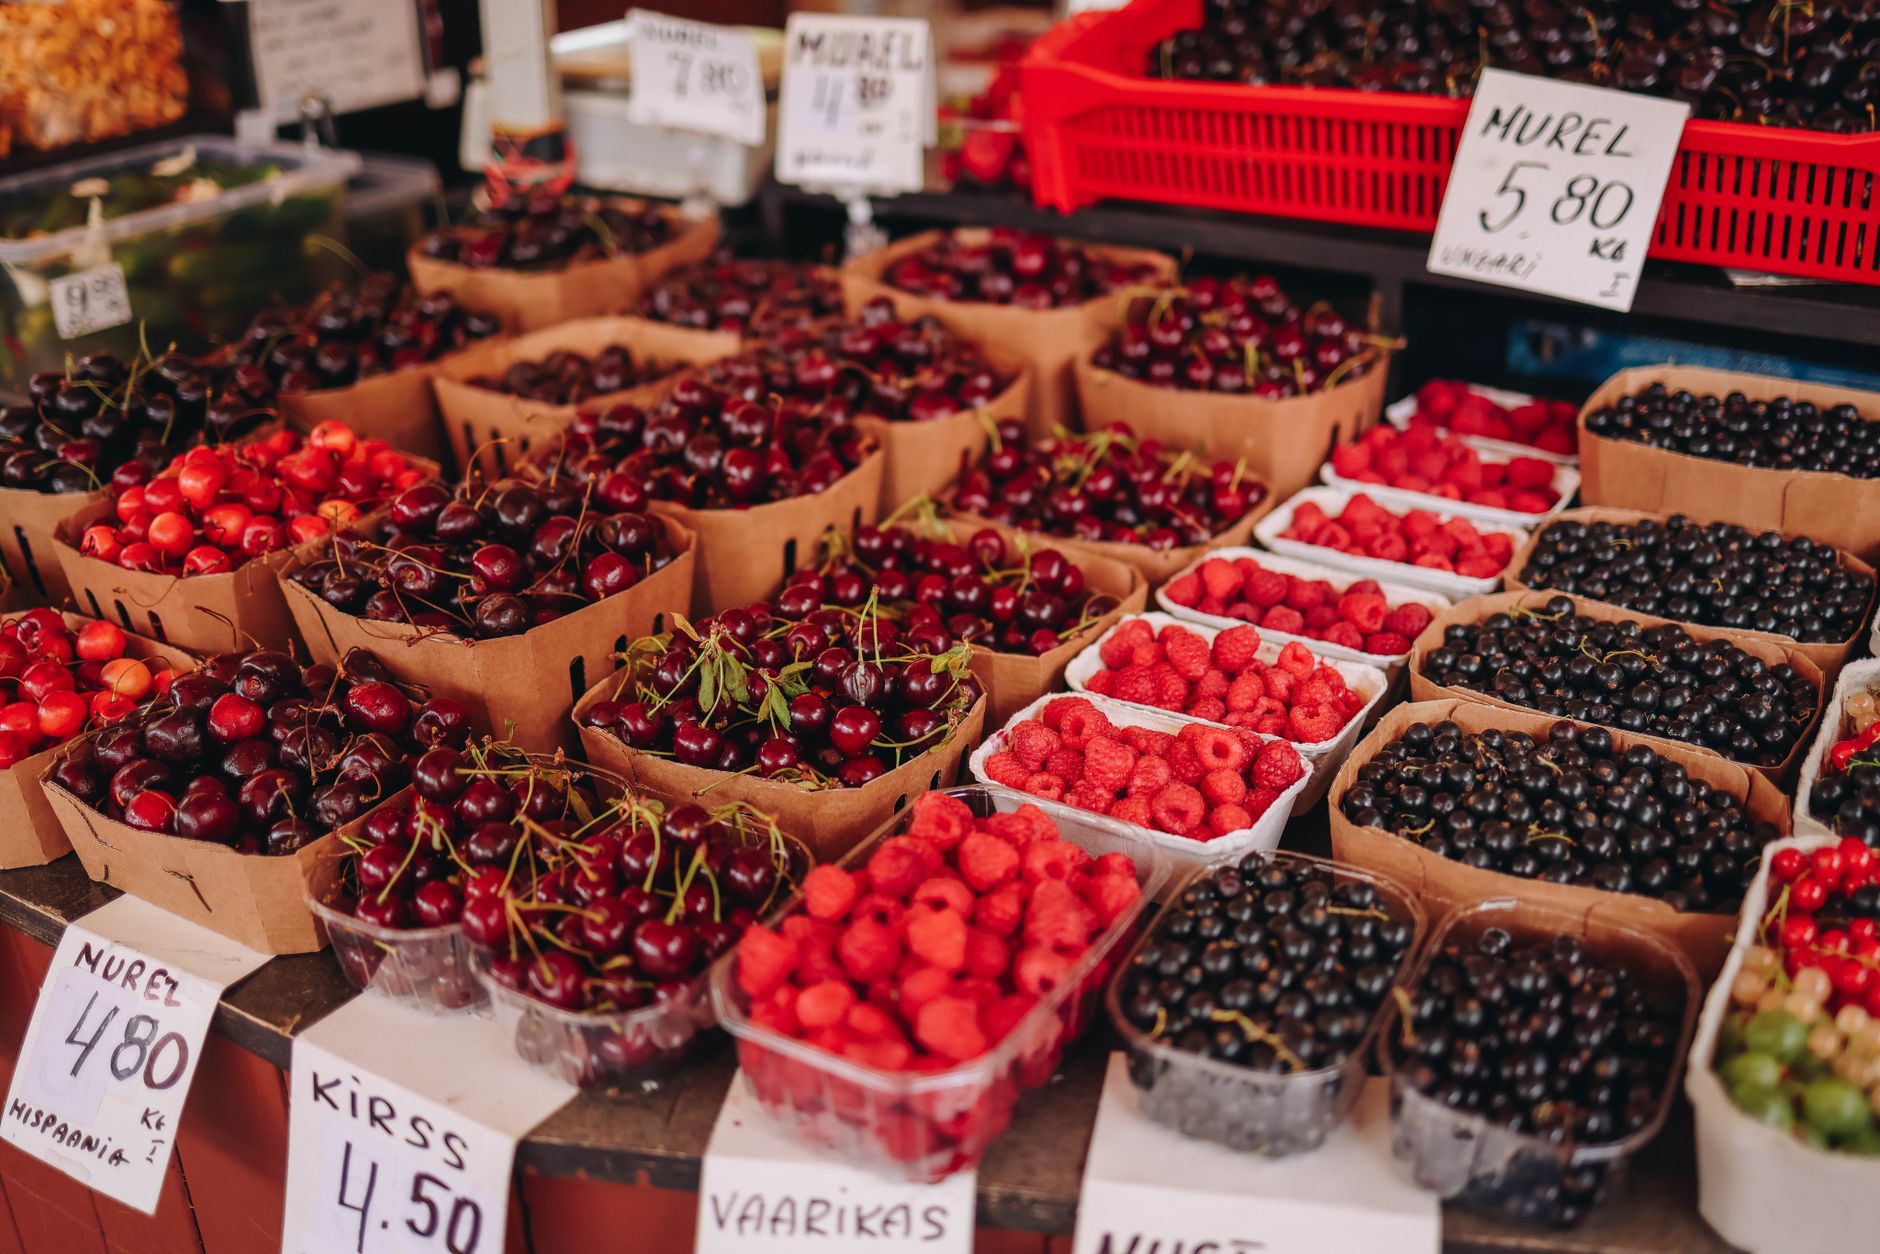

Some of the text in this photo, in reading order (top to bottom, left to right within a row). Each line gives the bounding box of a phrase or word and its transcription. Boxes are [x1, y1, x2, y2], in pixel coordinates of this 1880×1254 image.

[793, 31, 923, 71] MUREL
[1480, 103, 1634, 158] MUREL
[338, 1140, 483, 1254] 4.50
